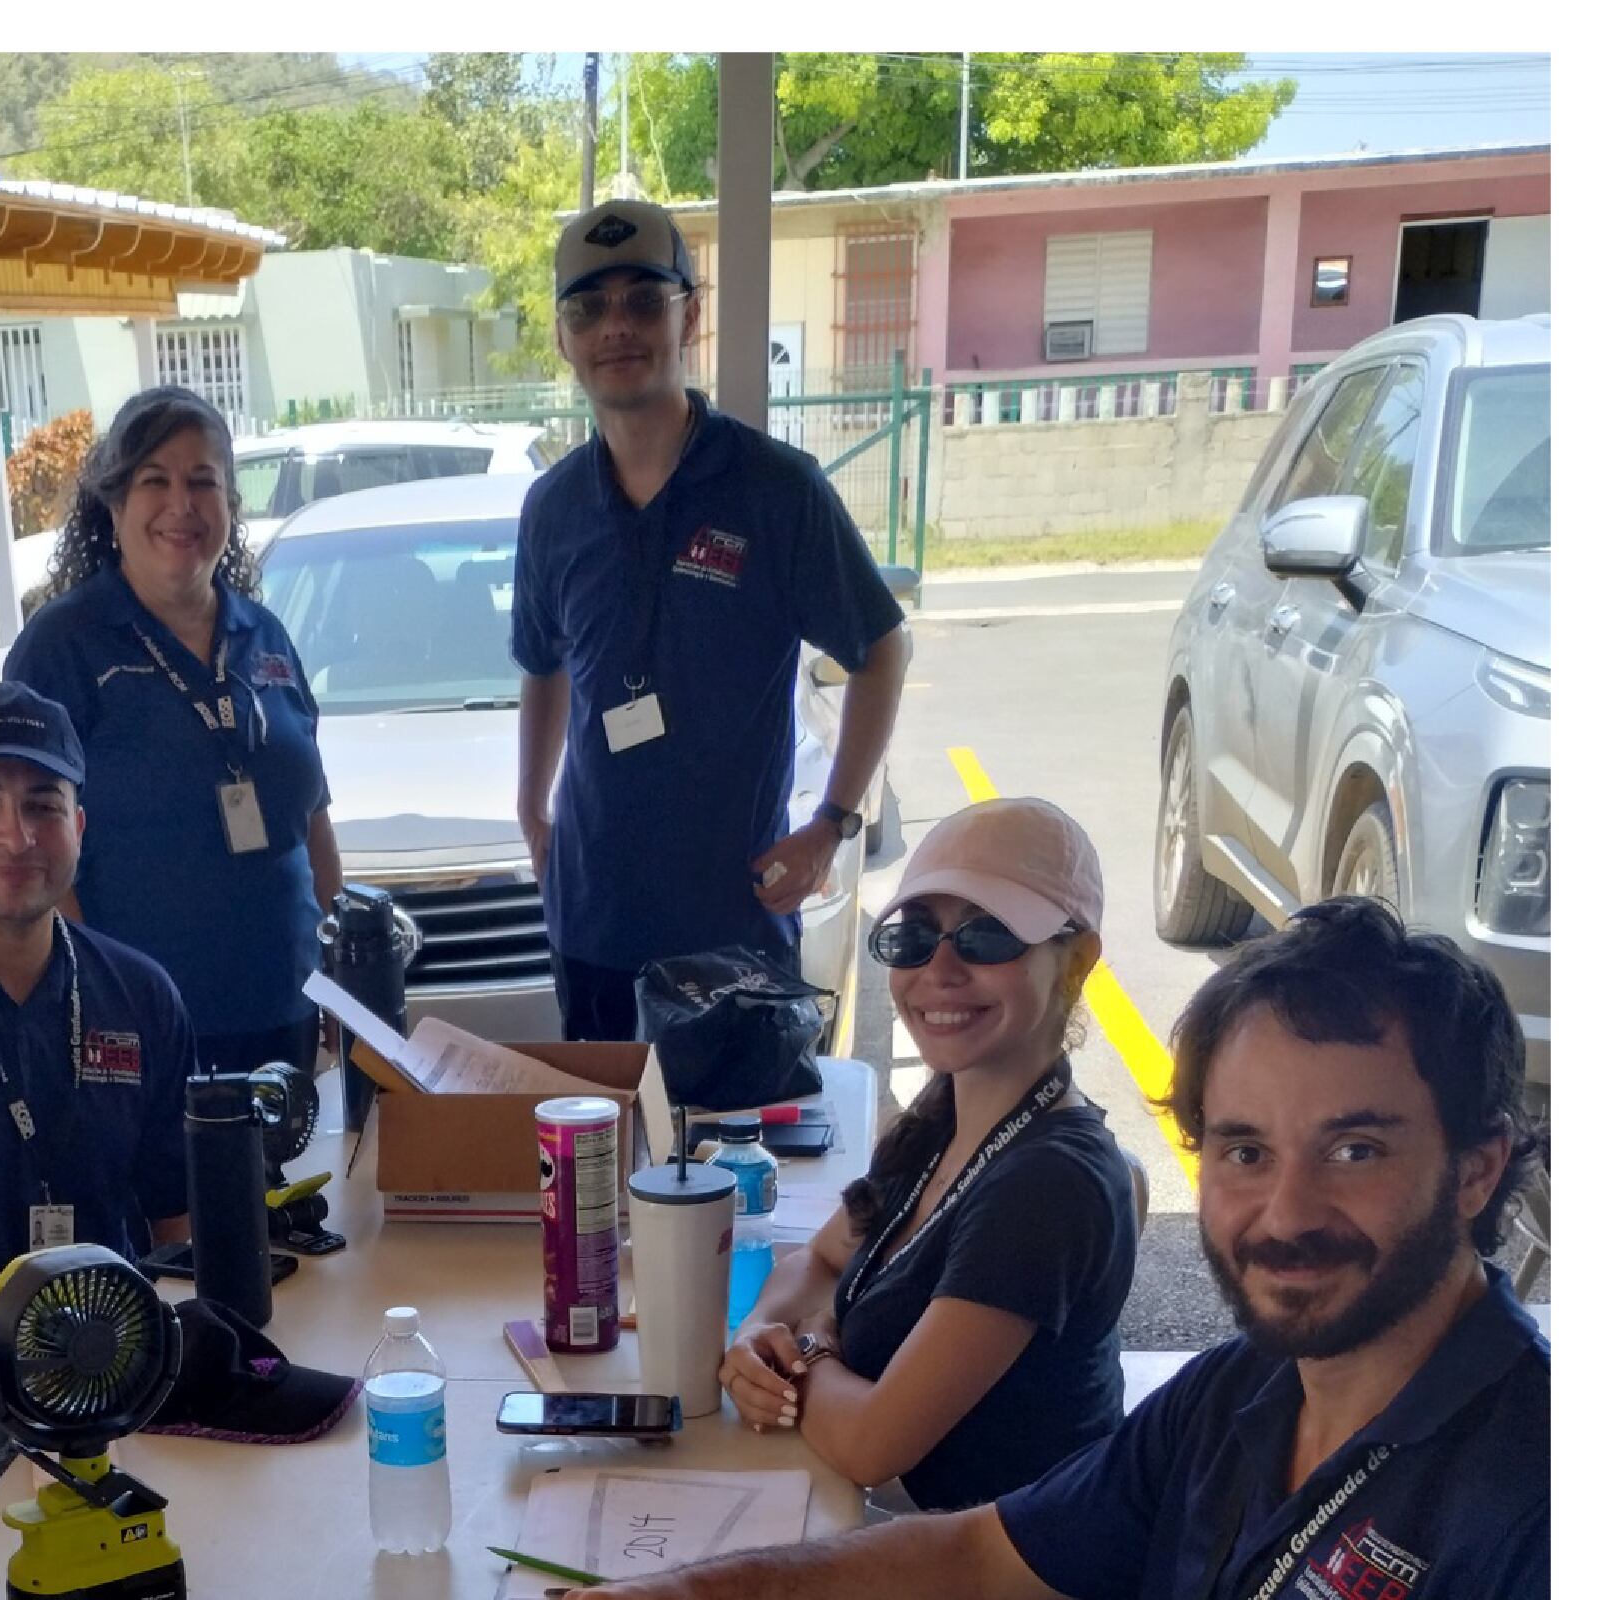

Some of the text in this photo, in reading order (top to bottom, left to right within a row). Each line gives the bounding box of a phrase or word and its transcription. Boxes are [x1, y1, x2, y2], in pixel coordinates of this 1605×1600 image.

[984, 1110, 1033, 1160] Pública
[1290, 1467, 1368, 1554] Graduada
[1367, 1445, 1390, 1471] de
[623, 1513, 677, 1559] 2014
